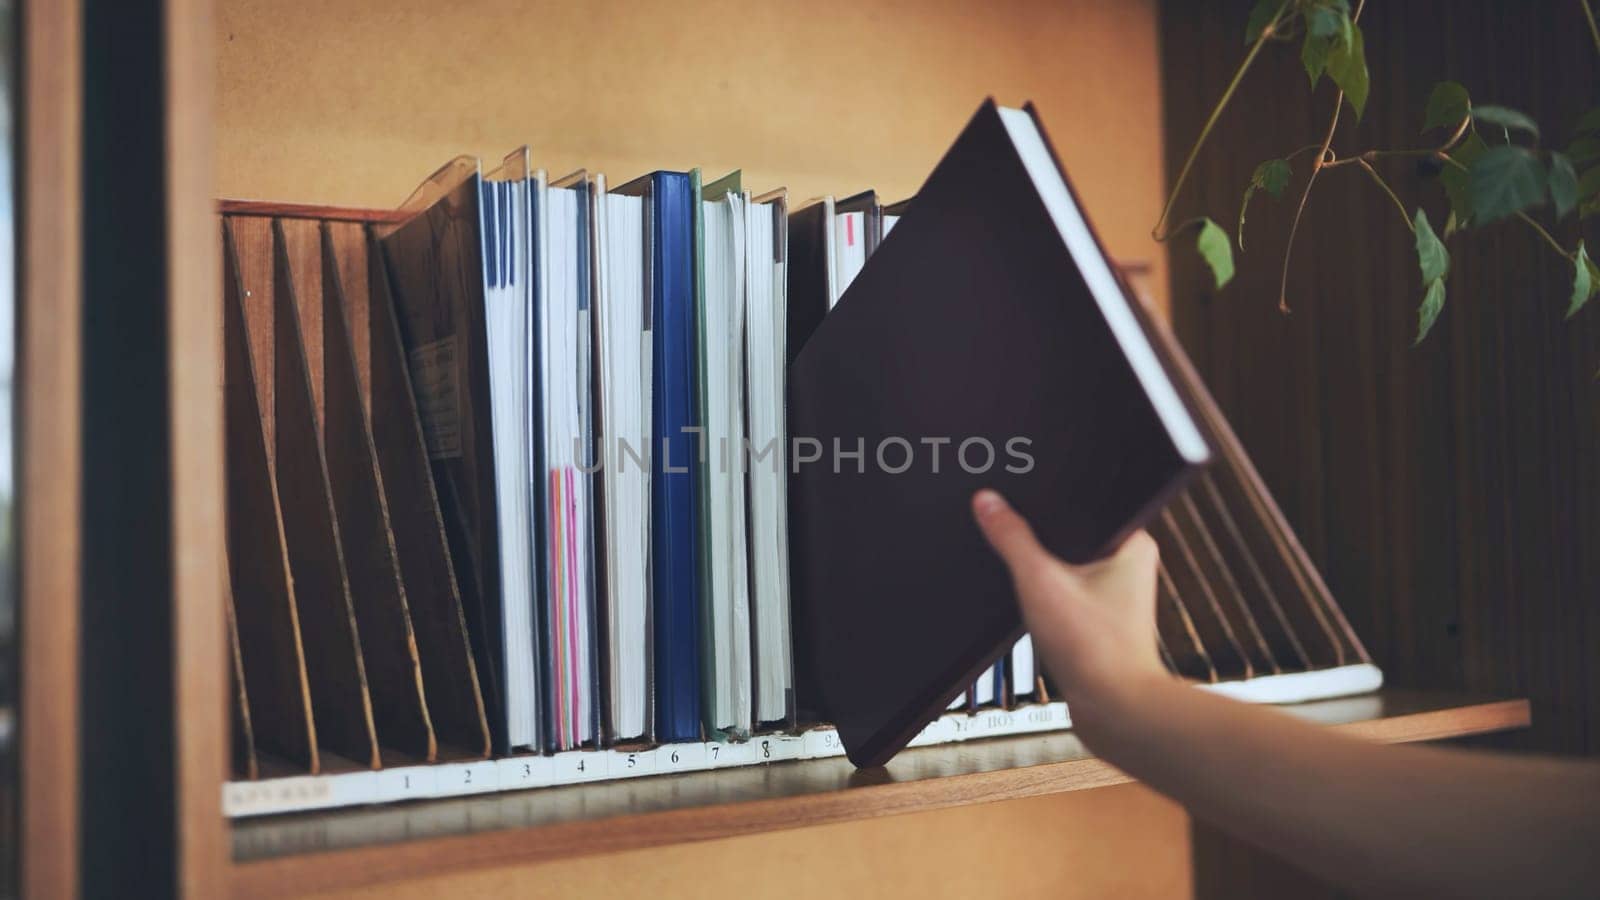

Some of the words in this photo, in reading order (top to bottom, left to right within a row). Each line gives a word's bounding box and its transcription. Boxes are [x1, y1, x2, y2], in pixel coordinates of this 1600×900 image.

[404, 775, 410, 789] 1
[464, 769, 472, 784] 2
[522, 764, 531, 778] 3
[577, 759, 585, 773] 4
[627, 754, 636, 768] 5
[671, 750, 679, 764] 6
[712, 747, 720, 760] 7
[761, 740, 770, 759] 8
